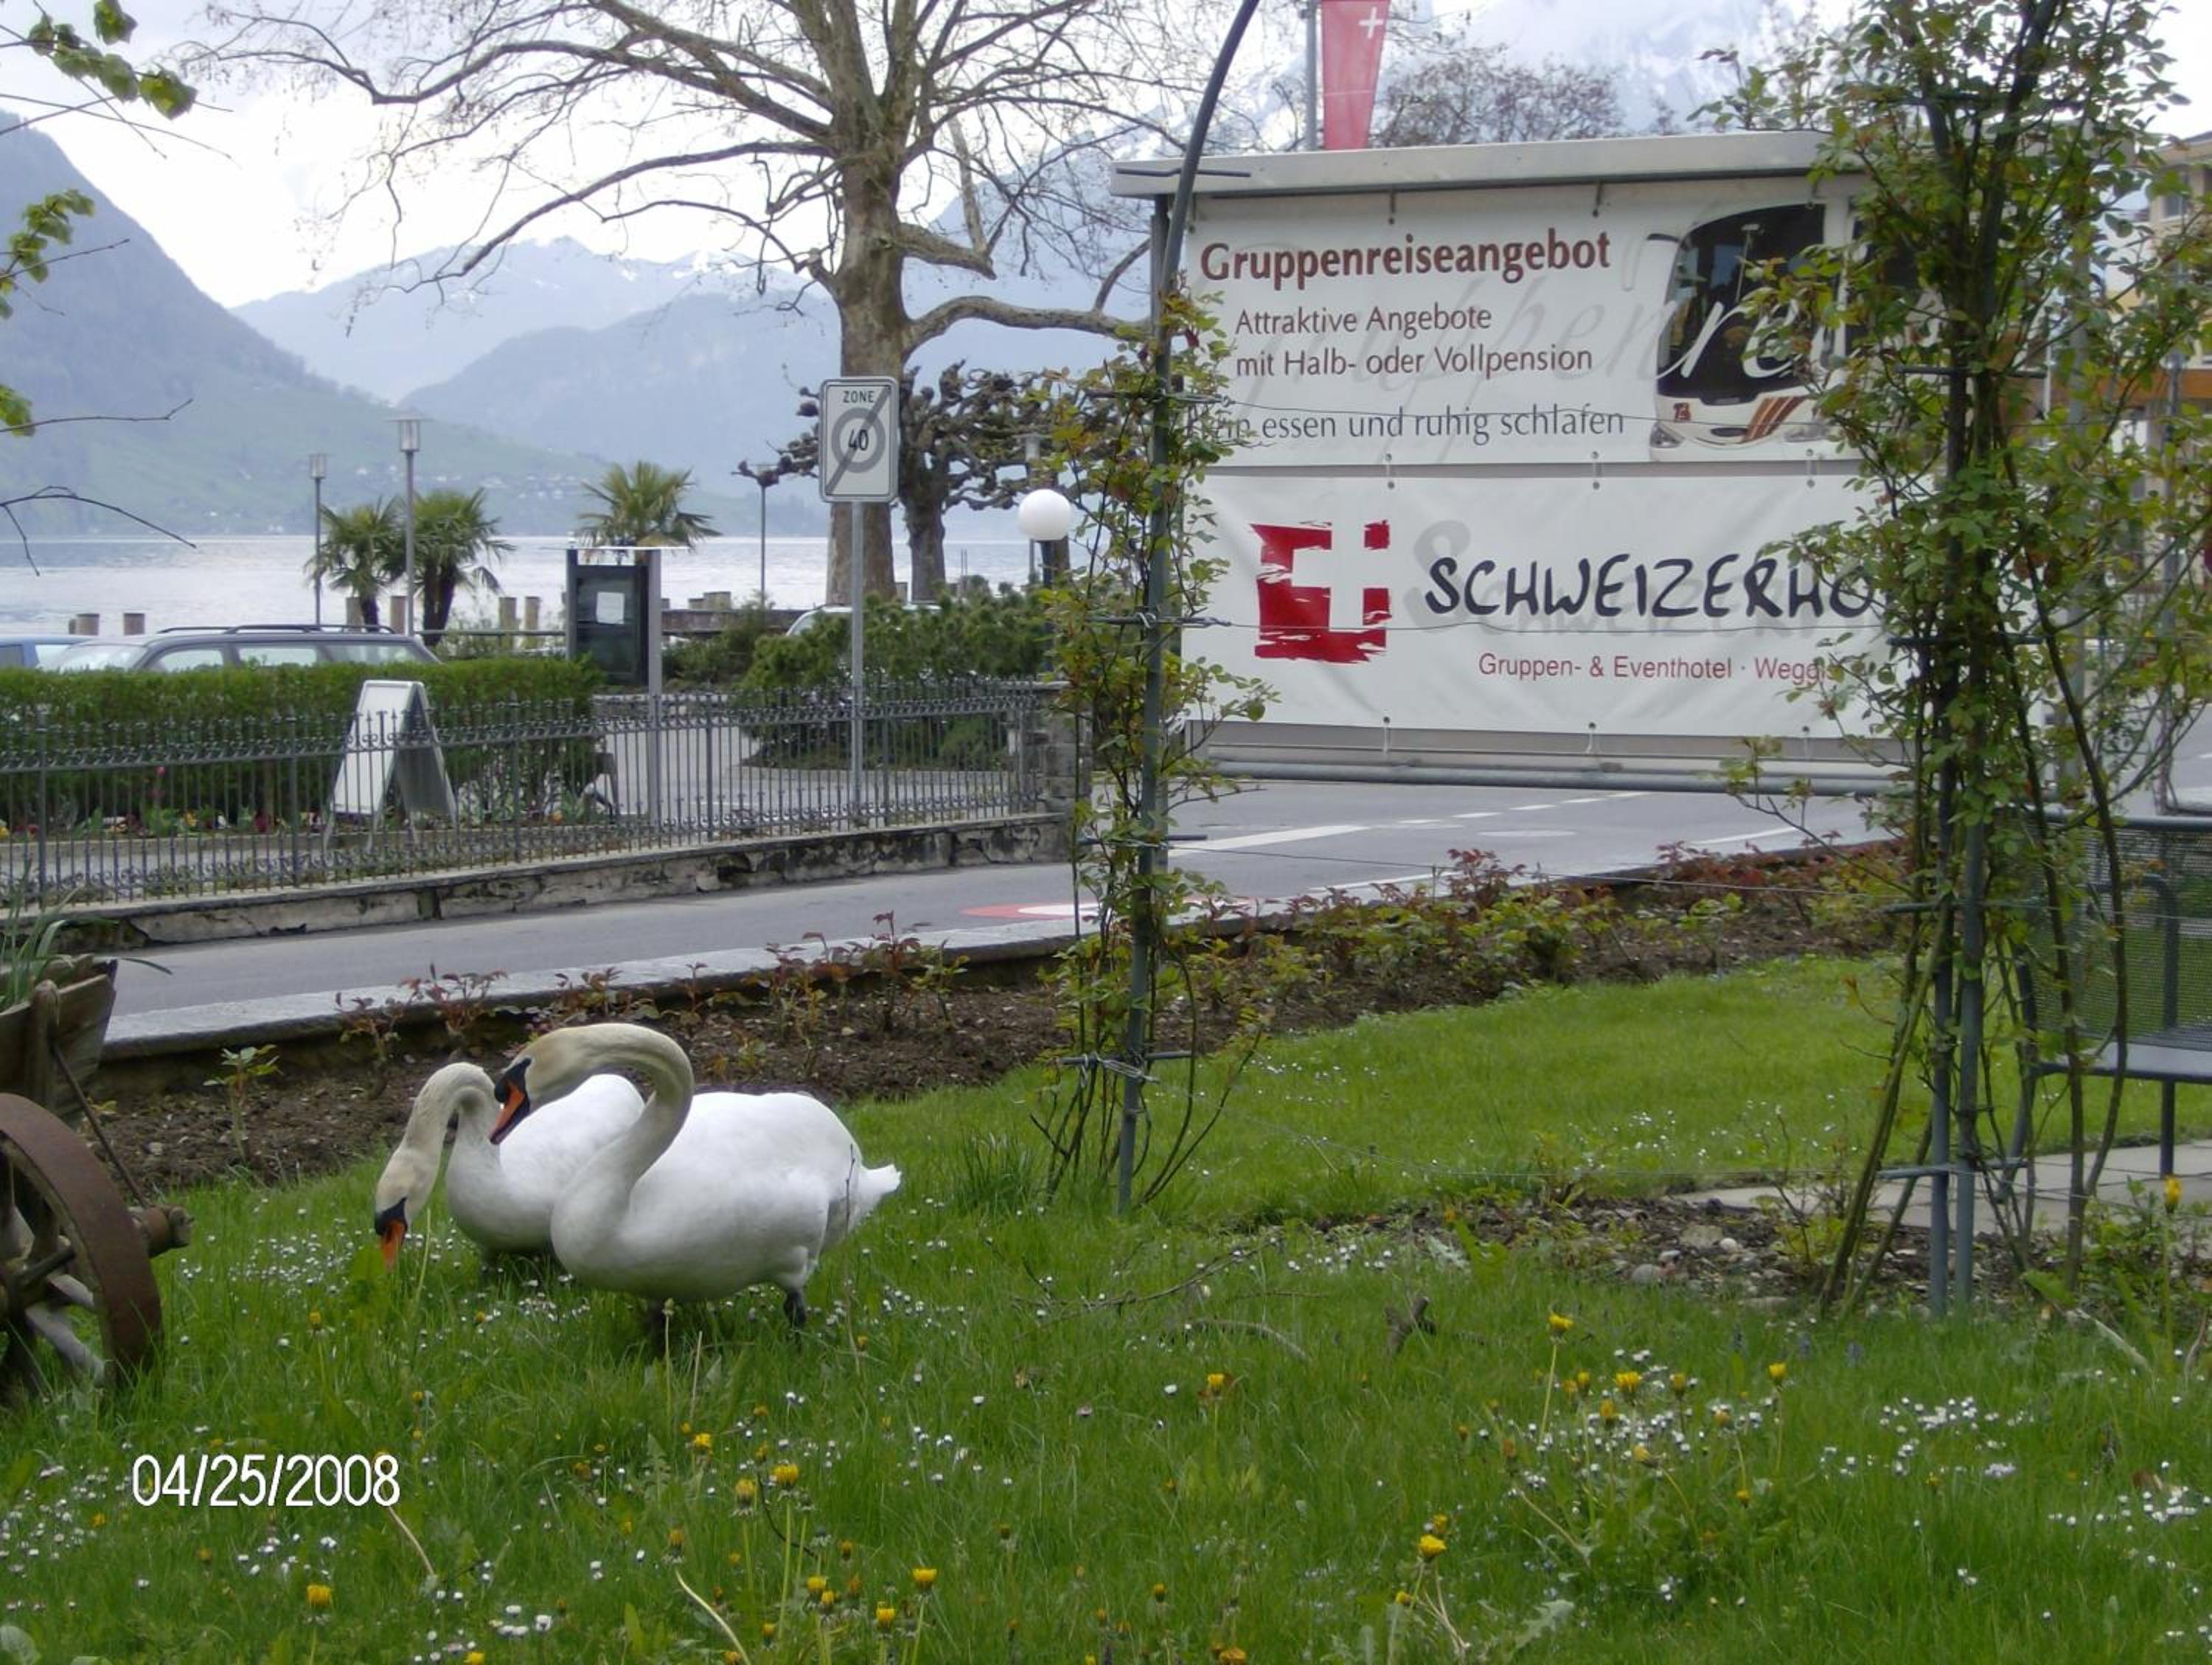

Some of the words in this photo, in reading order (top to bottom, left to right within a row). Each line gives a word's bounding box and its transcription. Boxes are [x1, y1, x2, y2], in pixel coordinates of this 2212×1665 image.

[1200, 227, 1611, 291] Gruppenreiseangebot
[1234, 307, 1358, 336] Attraktive
[1366, 302, 1492, 339] Angebote
[1236, 350, 1275, 378] mit
[1284, 348, 1357, 377] Halb-
[1366, 346, 1425, 375] oder
[1433, 344, 1593, 380] Vollpension
[842, 390, 875, 403] ZONE
[849, 428, 869, 451] 40
[1262, 416, 1336, 438] essen
[1349, 406, 1404, 438] und
[1414, 405, 1490, 446] ruhig
[1500, 403, 1624, 436] schlafen
[1423, 553, 1875, 619] SCHWEIZERHO
[1478, 653, 1582, 680] Gruppen-
[1588, 655, 1605, 678] &
[1613, 655, 1733, 680] Eventhotel
[1754, 656, 1832, 686] Wegg
